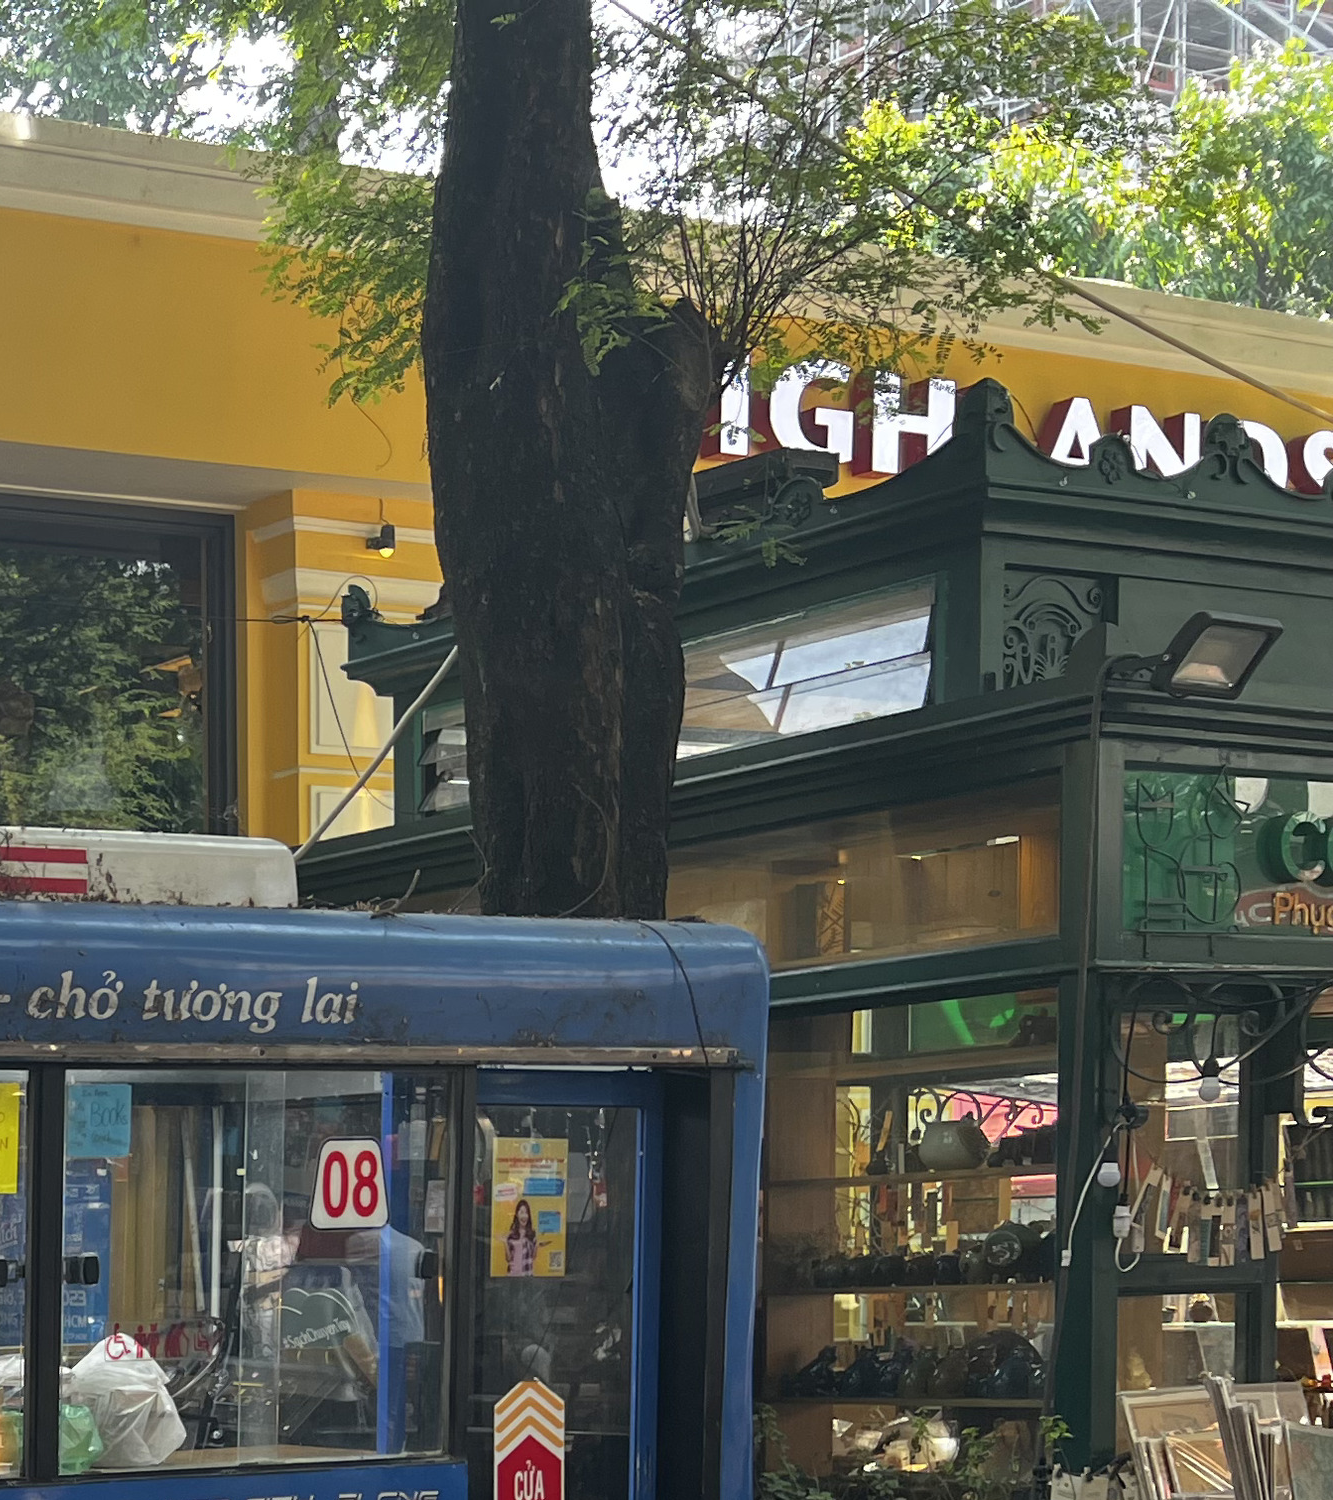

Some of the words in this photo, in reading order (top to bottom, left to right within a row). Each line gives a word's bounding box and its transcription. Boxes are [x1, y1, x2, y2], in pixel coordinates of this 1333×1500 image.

[719, 353, 1333, 490] IGHAND
[26, 970, 123, 1022] chở
[142, 979, 283, 1034] tương
[300, 976, 361, 1026] lai
[321, 1149, 379, 1218] 08
